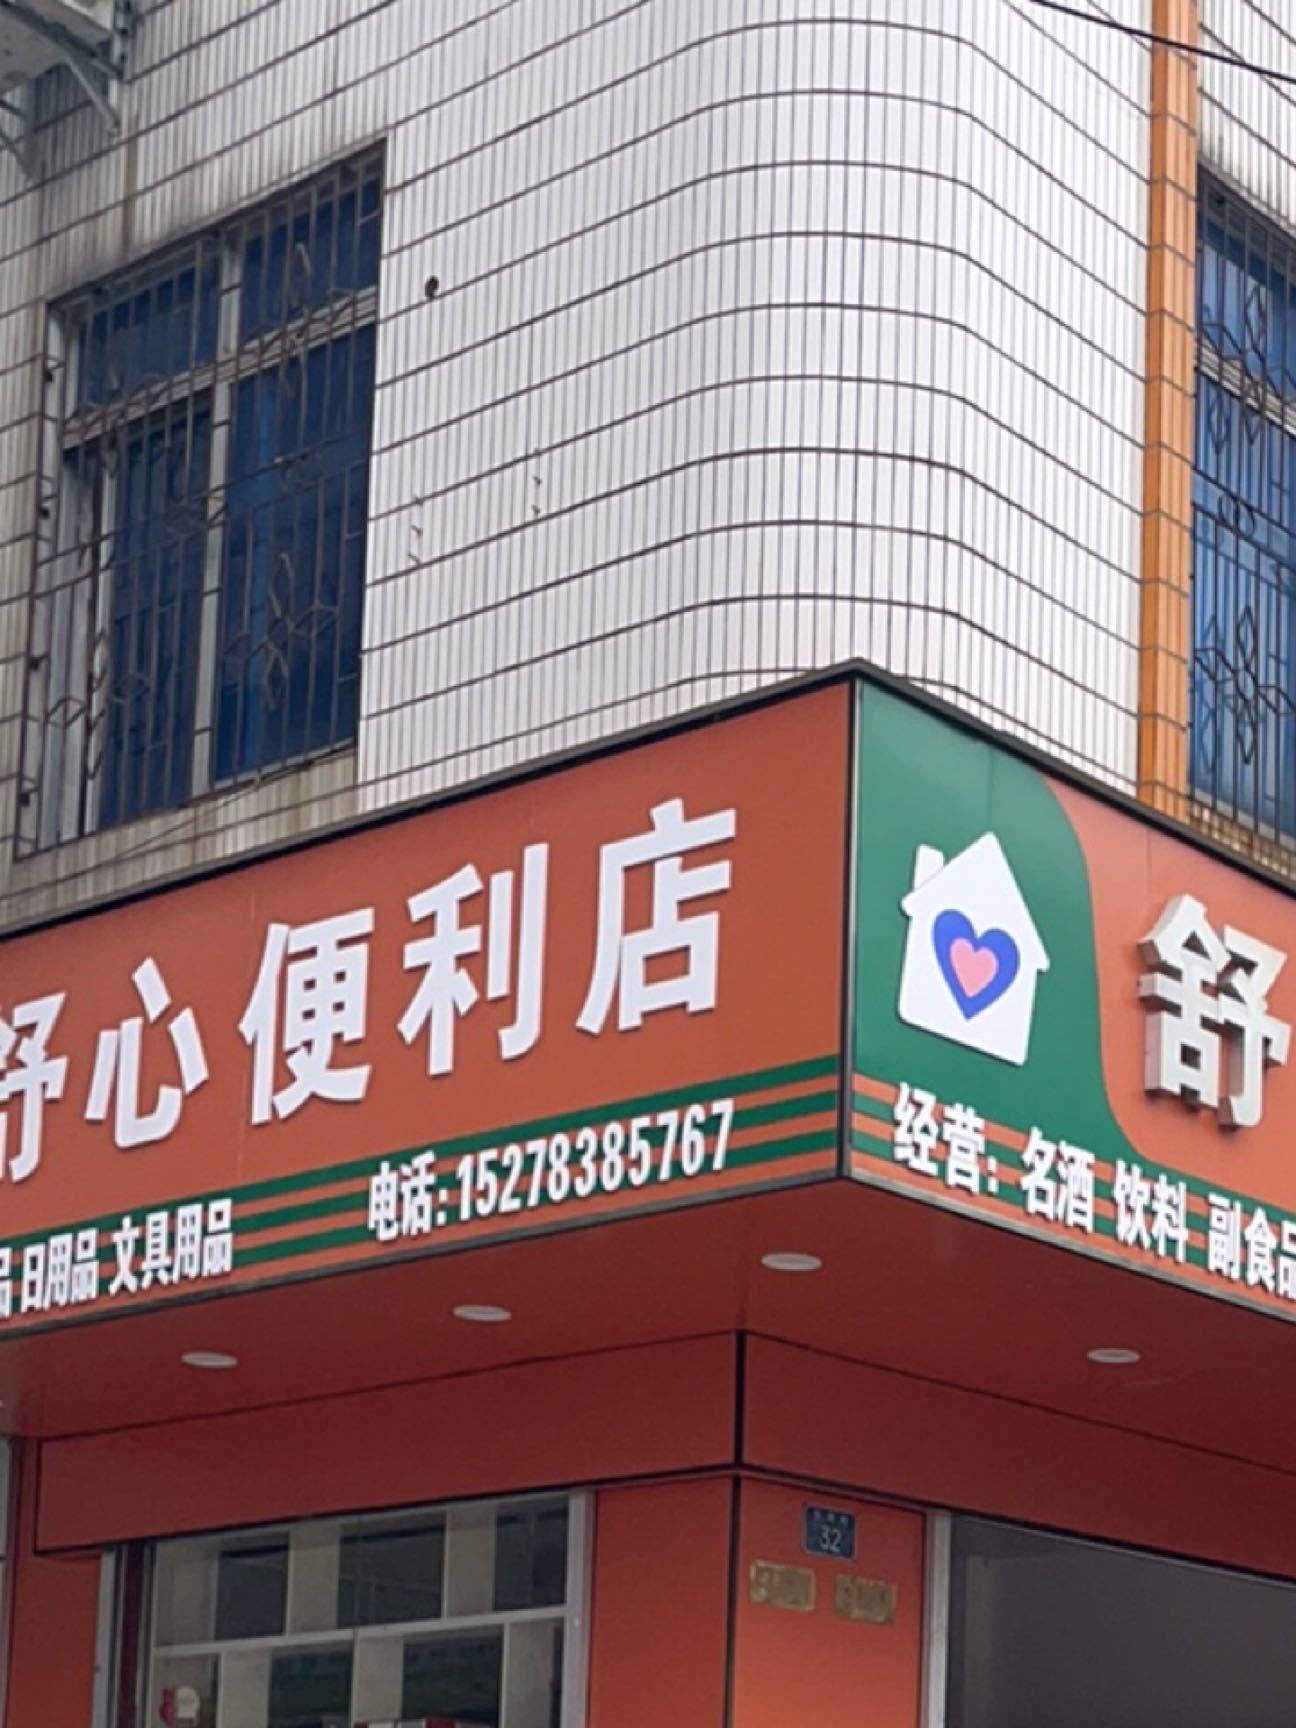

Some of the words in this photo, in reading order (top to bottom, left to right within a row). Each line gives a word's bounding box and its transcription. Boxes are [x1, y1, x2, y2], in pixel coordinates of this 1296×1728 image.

[1020, 1127, 1096, 1234] 名酒
[1113, 1160, 1189, 1264] 饮料
[21, 1228, 98, 1313] 日用品
[108, 1198, 233, 1297] 文具用品
[820, 1525, 842, 1553] 32
